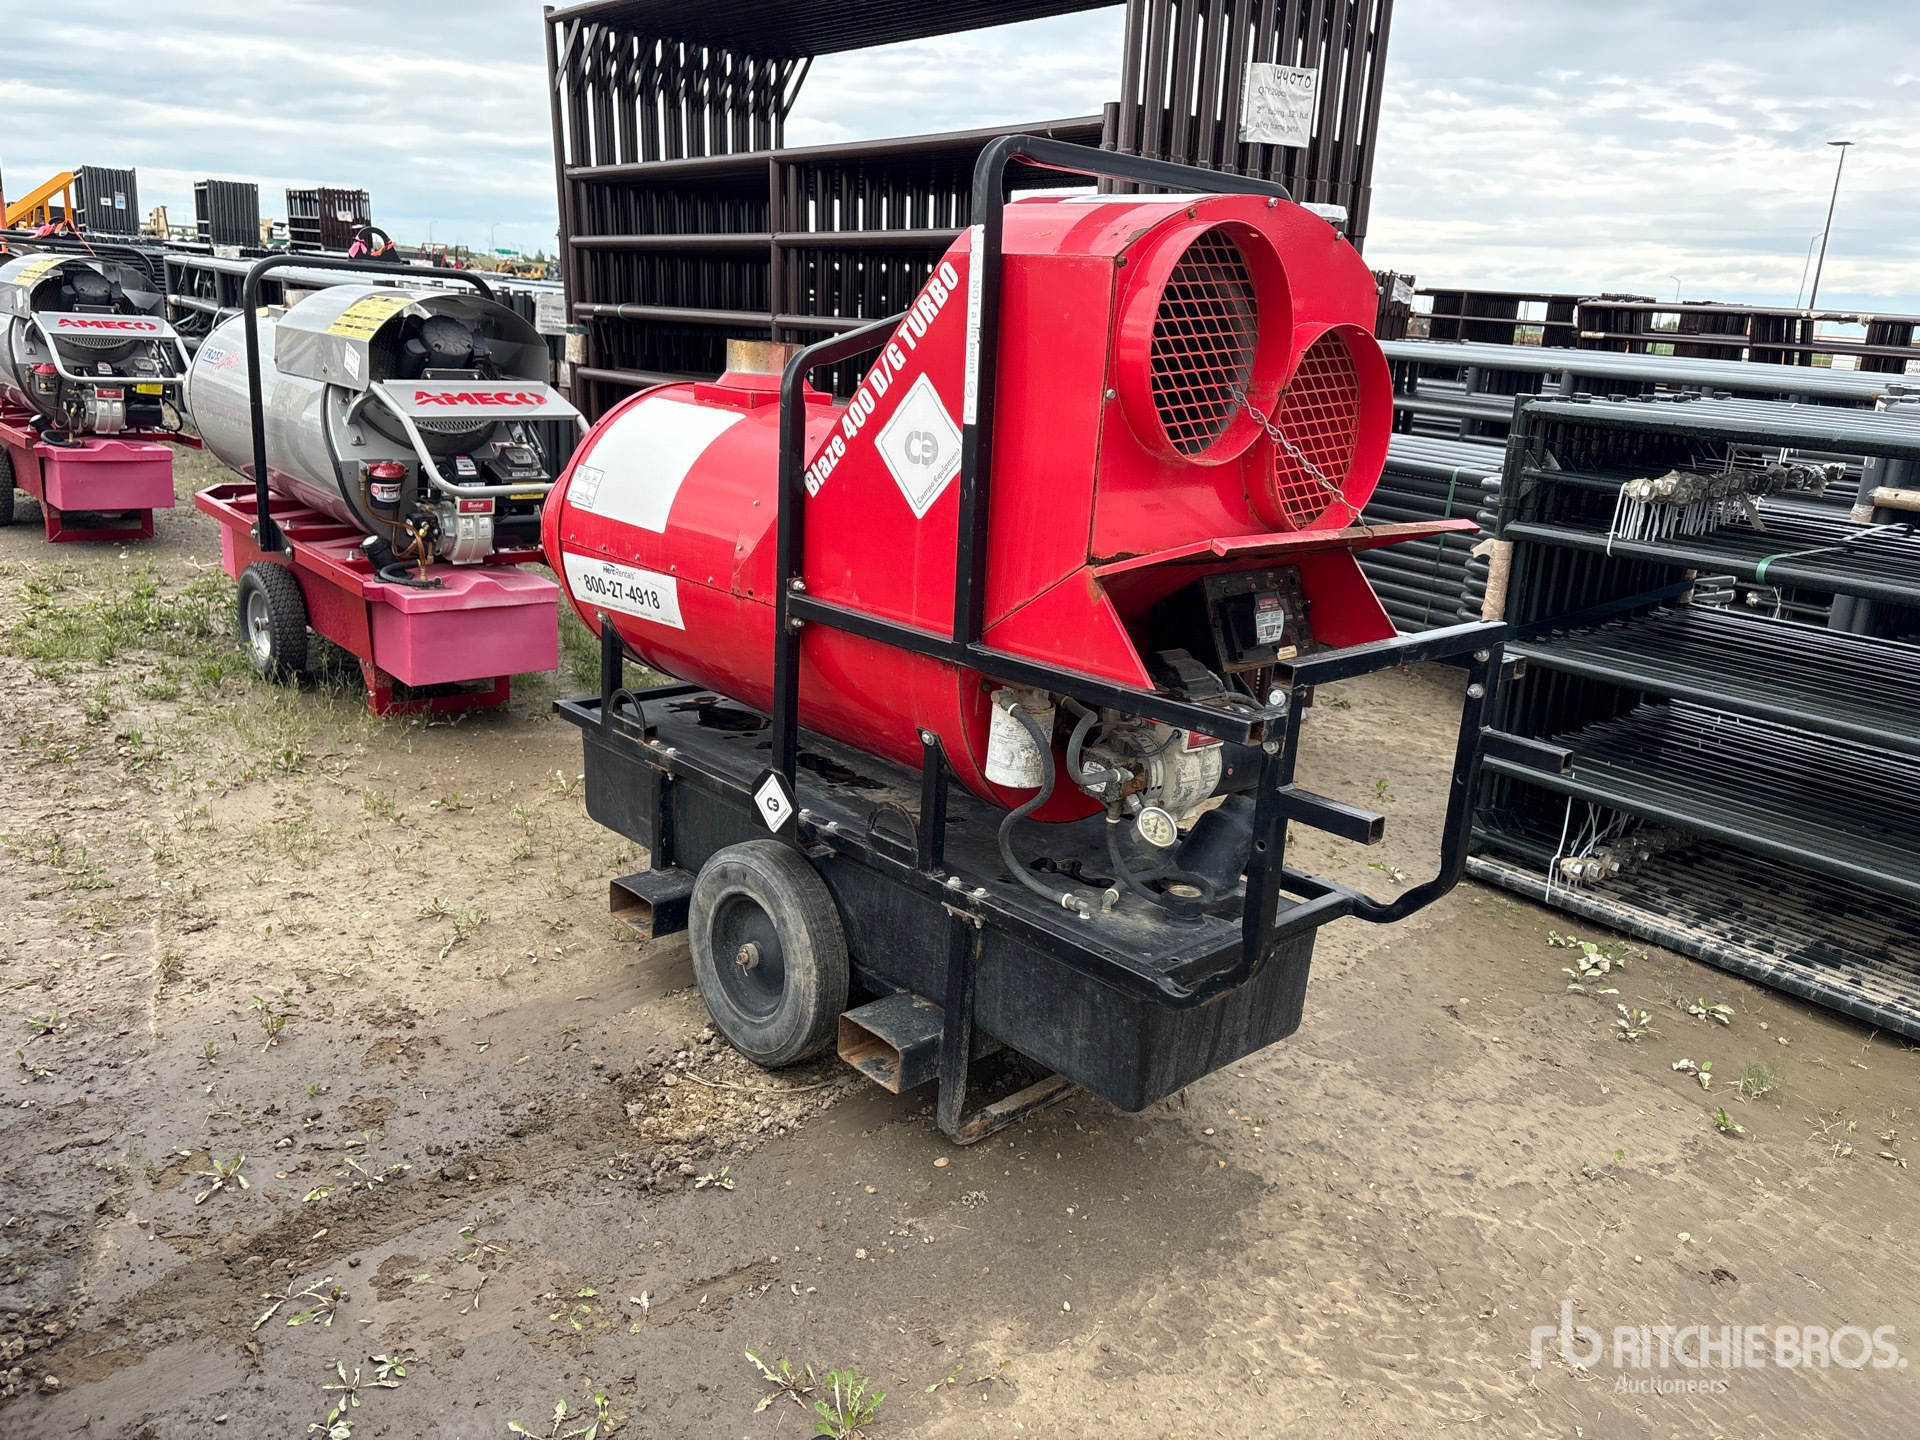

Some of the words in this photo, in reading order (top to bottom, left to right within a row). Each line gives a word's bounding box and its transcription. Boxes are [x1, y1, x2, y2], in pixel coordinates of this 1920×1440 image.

[1272, 68, 1312, 89] 144070
[971, 279, 980, 309] NOT
[57, 318, 157, 331] AMECO
[970, 322, 980, 339] lift
[967, 340, 978, 374] point
[803, 433, 846, 498] Blaze
[841, 387, 876, 440] 400
[868, 342, 907, 399] D/G
[897, 261, 959, 350] TURBO
[414, 390, 548, 406] AMECO
[916, 482, 936, 504] Campo
[933, 448, 961, 483] Equipment
[583, 573, 661, 610] 800-27-4918
